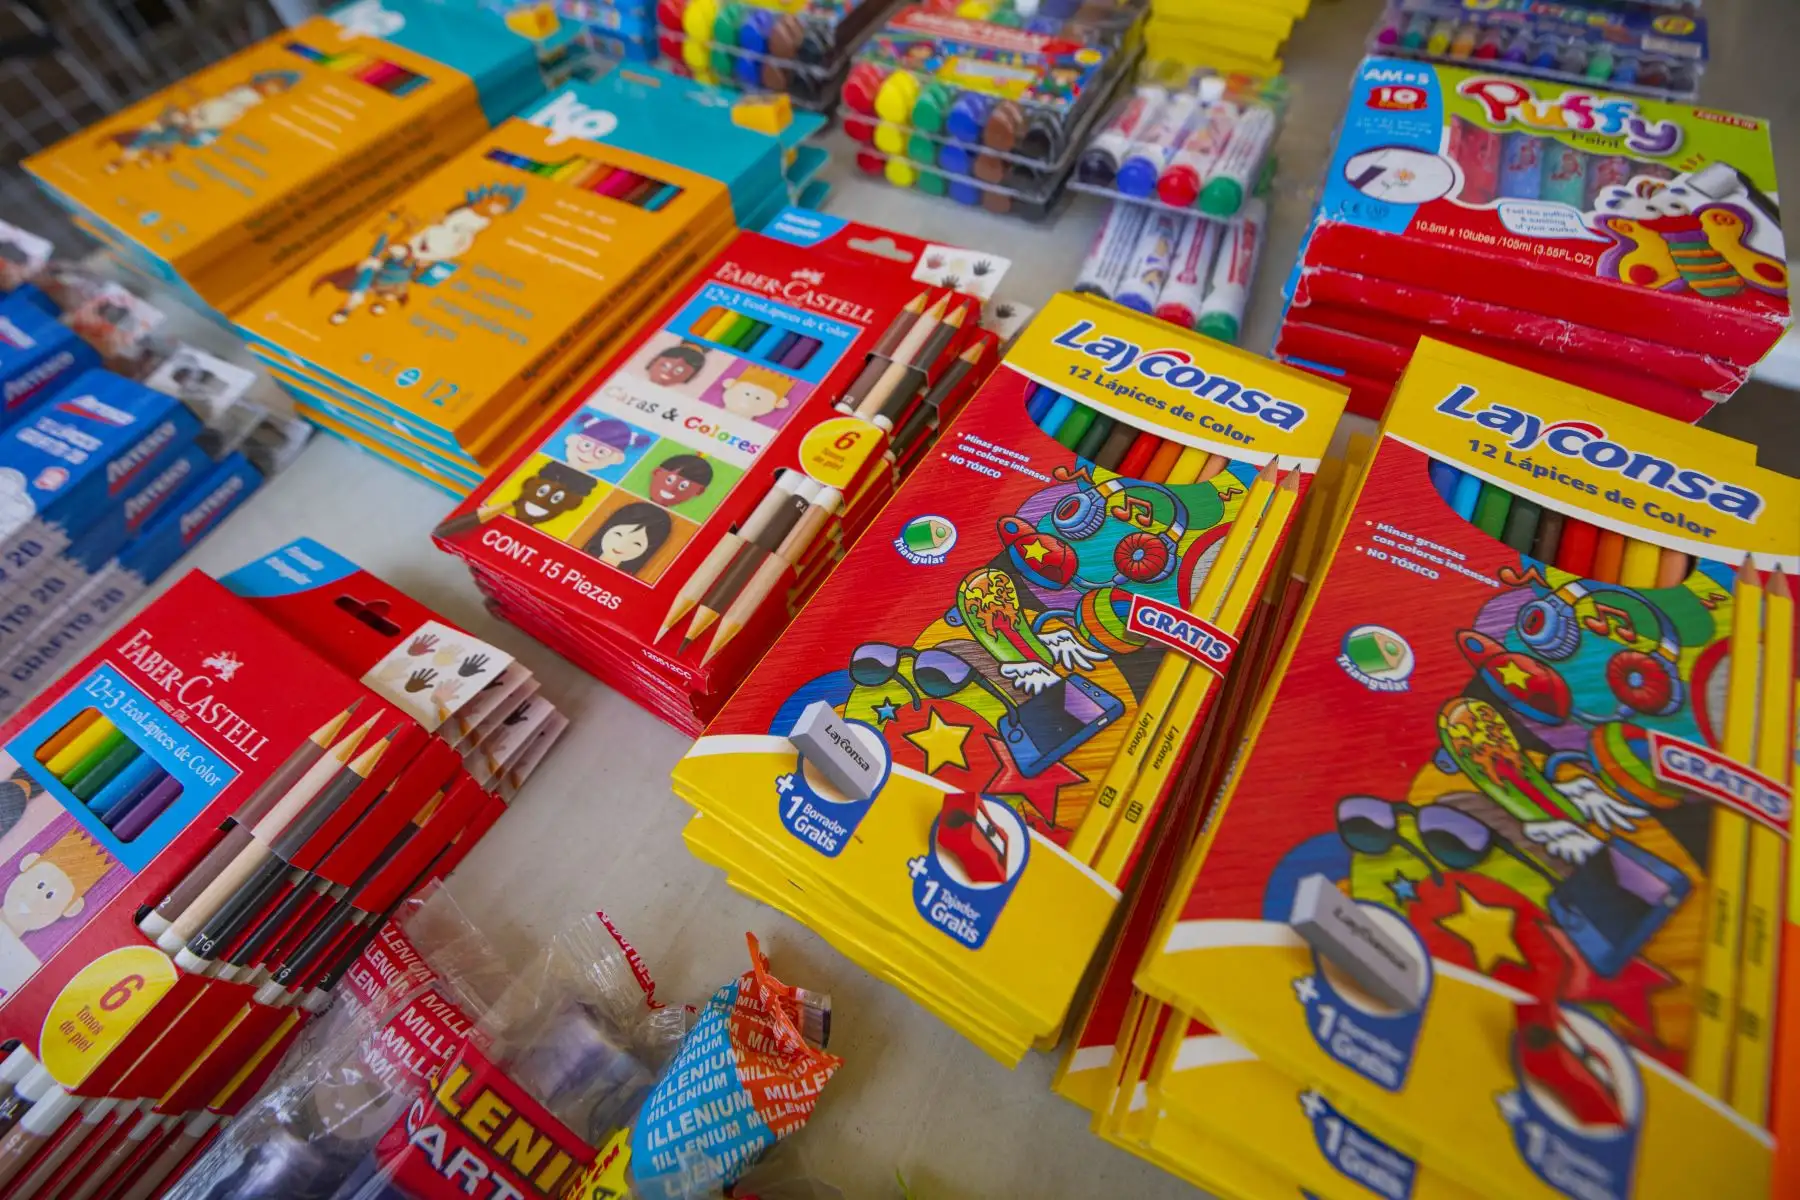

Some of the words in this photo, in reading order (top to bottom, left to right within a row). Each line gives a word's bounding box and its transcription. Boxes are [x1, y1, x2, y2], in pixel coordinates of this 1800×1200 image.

[1457, 77, 1683, 156] Puffy
[1415, 220, 1448, 235] 10.5ml
[1449, 228, 1455, 238] x
[1458, 228, 1495, 246] 10tubes
[1533, 244, 1595, 267] (3.55FL.OZ)
[604, 384, 660, 415] Caras
[661, 407, 679, 422] &
[684, 416, 761, 454] Colores
[1069, 365, 1091, 381] 12
[1094, 373, 1168, 411] Lápices
[1170, 405, 1195, 422] de
[1199, 415, 1256, 445] Color
[834, 431, 861, 450] 6
[964, 433, 993, 449] Minas
[992, 444, 1030, 464] gruesas
[949, 454, 965, 466] NO
[966, 458, 1002, 480] TÓXICO
[958, 443, 975, 454] con
[976, 448, 1010, 468] colores
[1010, 461, 1052, 483] intensos
[1468, 438, 1496, 460] 12
[1503, 448, 1599, 498] Lápices
[1604, 487, 1637, 510] de
[1643, 499, 1718, 542] Color
[894, 537, 945, 565] Triangular
[1372, 534, 1396, 547] con
[1397, 542, 1444, 565] colores
[1445, 559, 1500, 588] intensos
[1376, 522, 1415, 541] Minas
[1416, 537, 1467, 561] gruesas
[482, 529, 538, 567] CONT.
[538, 558, 564, 579] 15
[561, 568, 622, 611] Piezas
[1367, 547, 1388, 561] NO
[1390, 554, 1440, 580] TÓXICO
[1138, 606, 1231, 663] GRATIS
[1337, 655, 1409, 691] Triangular
[85, 674, 126, 709] 12+3
[174, 744, 191, 762] de
[188, 755, 222, 788] Color
[1662, 748, 1786, 816] GRATIS
[786, 796, 804, 819] 1
[803, 803, 847, 838] Borrador
[794, 816, 838, 852] Gratis
[921, 880, 939, 907] 1
[931, 902, 980, 943] Gratis
[195, 932, 216, 953] T6
[100, 974, 145, 1012] 6
[1317, 1004, 1338, 1042] 1
[1324, 1119, 1341, 1154] 1
